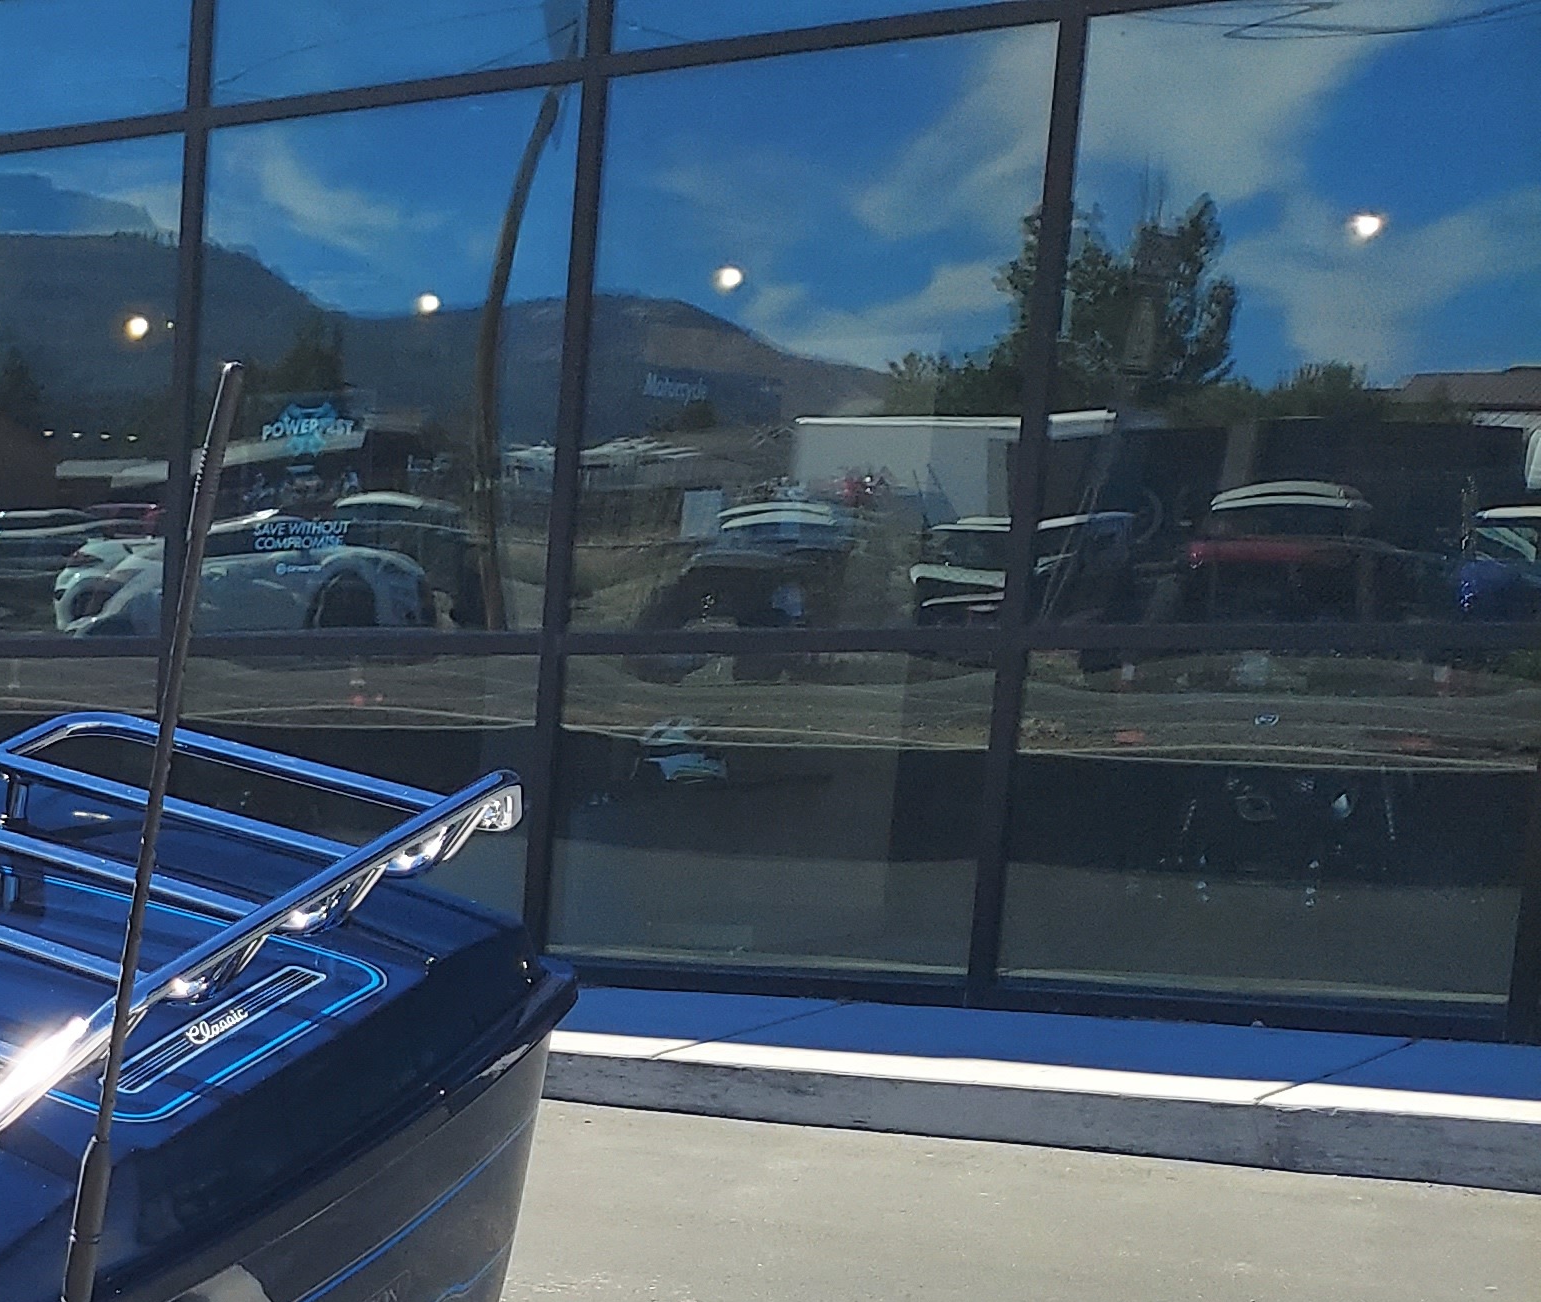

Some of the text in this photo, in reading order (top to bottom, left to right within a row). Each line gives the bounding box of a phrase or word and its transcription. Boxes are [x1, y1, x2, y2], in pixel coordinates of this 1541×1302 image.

[253, 520, 351, 536] SAVE WITHOUT
[255, 535, 345, 550] COMPROMISE
[185, 1008, 249, 1045] Classic
